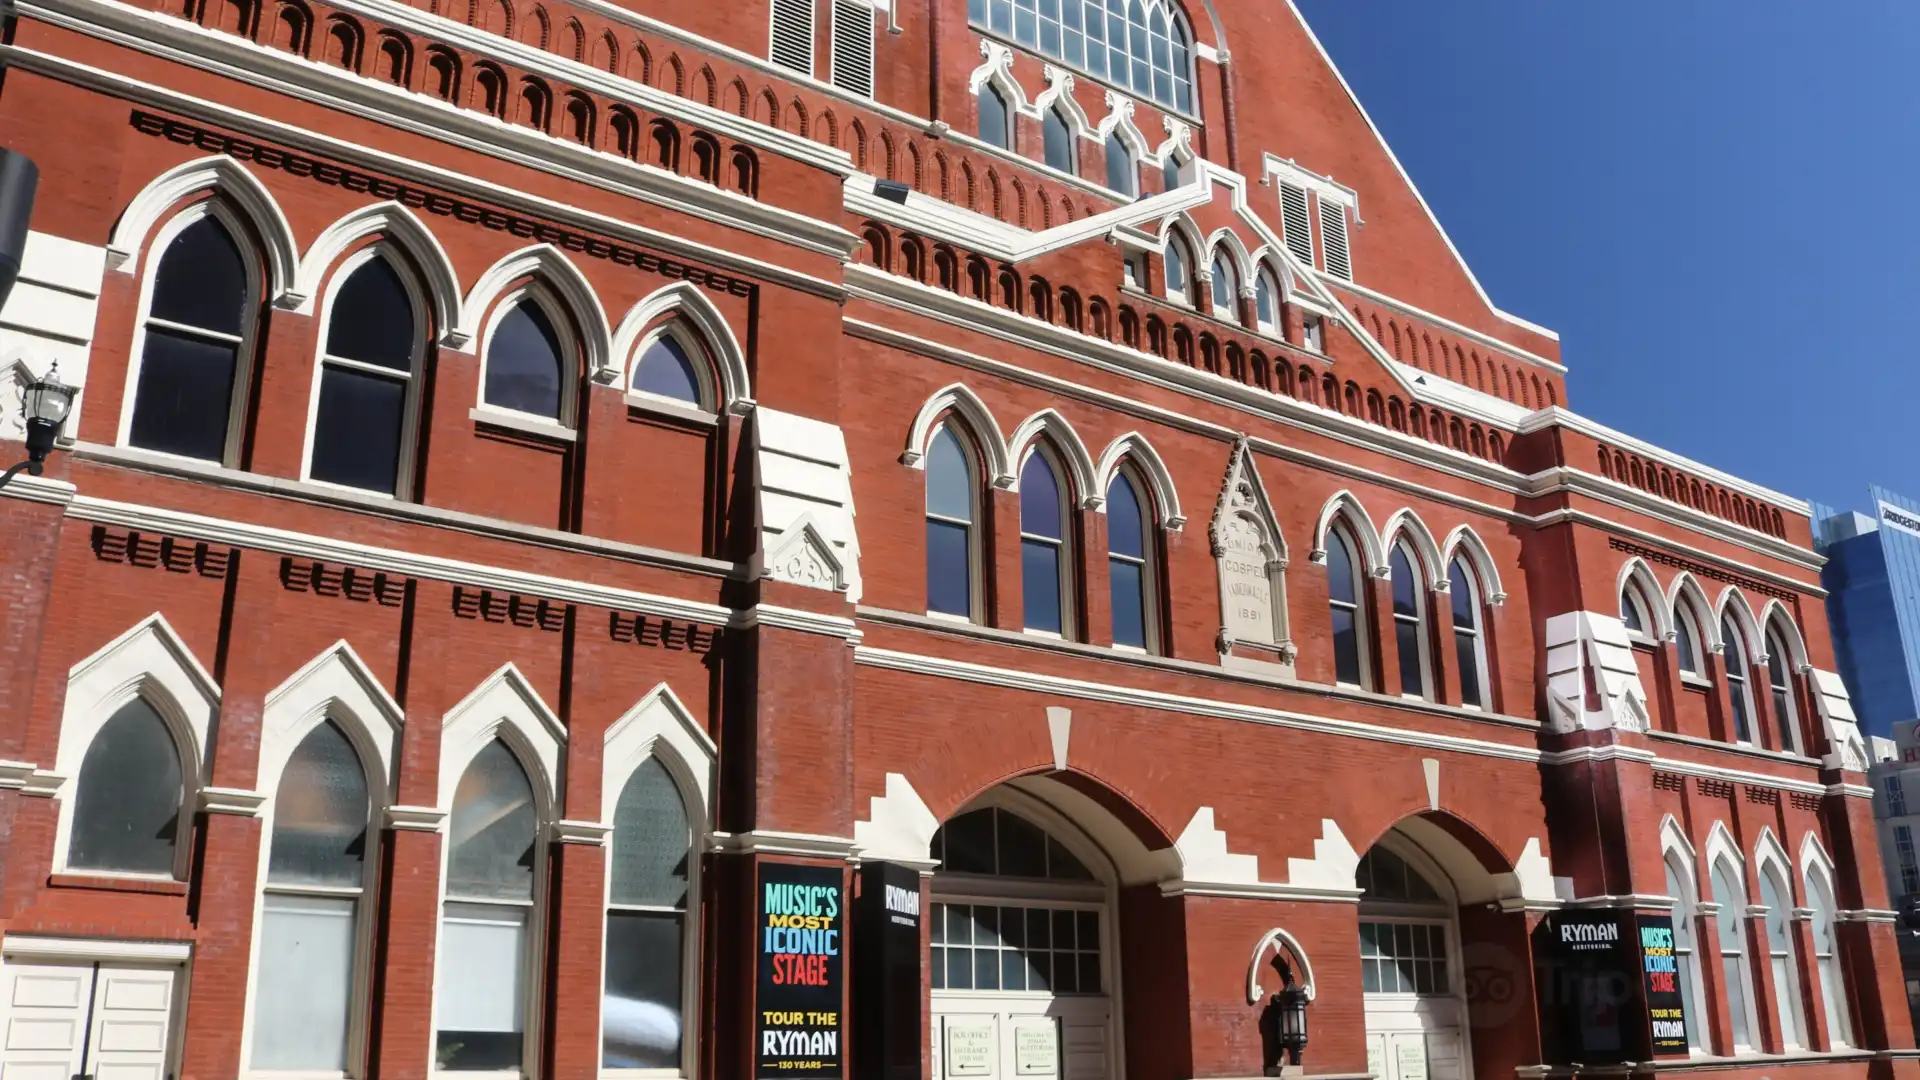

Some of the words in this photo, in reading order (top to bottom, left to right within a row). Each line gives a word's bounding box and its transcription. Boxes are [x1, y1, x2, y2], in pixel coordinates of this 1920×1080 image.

[1225, 559, 1266, 579] GOSPEL
[1238, 608, 1262, 621] 1891
[765, 882, 838, 917] MUSIC'S
[885, 884, 919, 916] RYMAN
[768, 914, 834, 930] MOST
[1560, 922, 1618, 942] RYMAN
[764, 926, 838, 955] ICONIC
[1640, 927, 1673, 948] MUSIC'S
[1645, 947, 1672, 956] MOST
[772, 954, 828, 986] STAGE
[1644, 955, 1677, 973] ICONIC
[1650, 972, 1676, 993] STAGE
[763, 1011, 804, 1025] TOUR
[807, 1012, 837, 1026] THE
[1651, 1009, 1668, 1018] TOUR
[1668, 1009, 1682, 1018] THE
[1652, 1021, 1684, 1037] RYMAN
[762, 1030, 837, 1056] RYMAN
[778, 1061, 793, 1069] 130
[794, 1061, 822, 1069] YEARS
